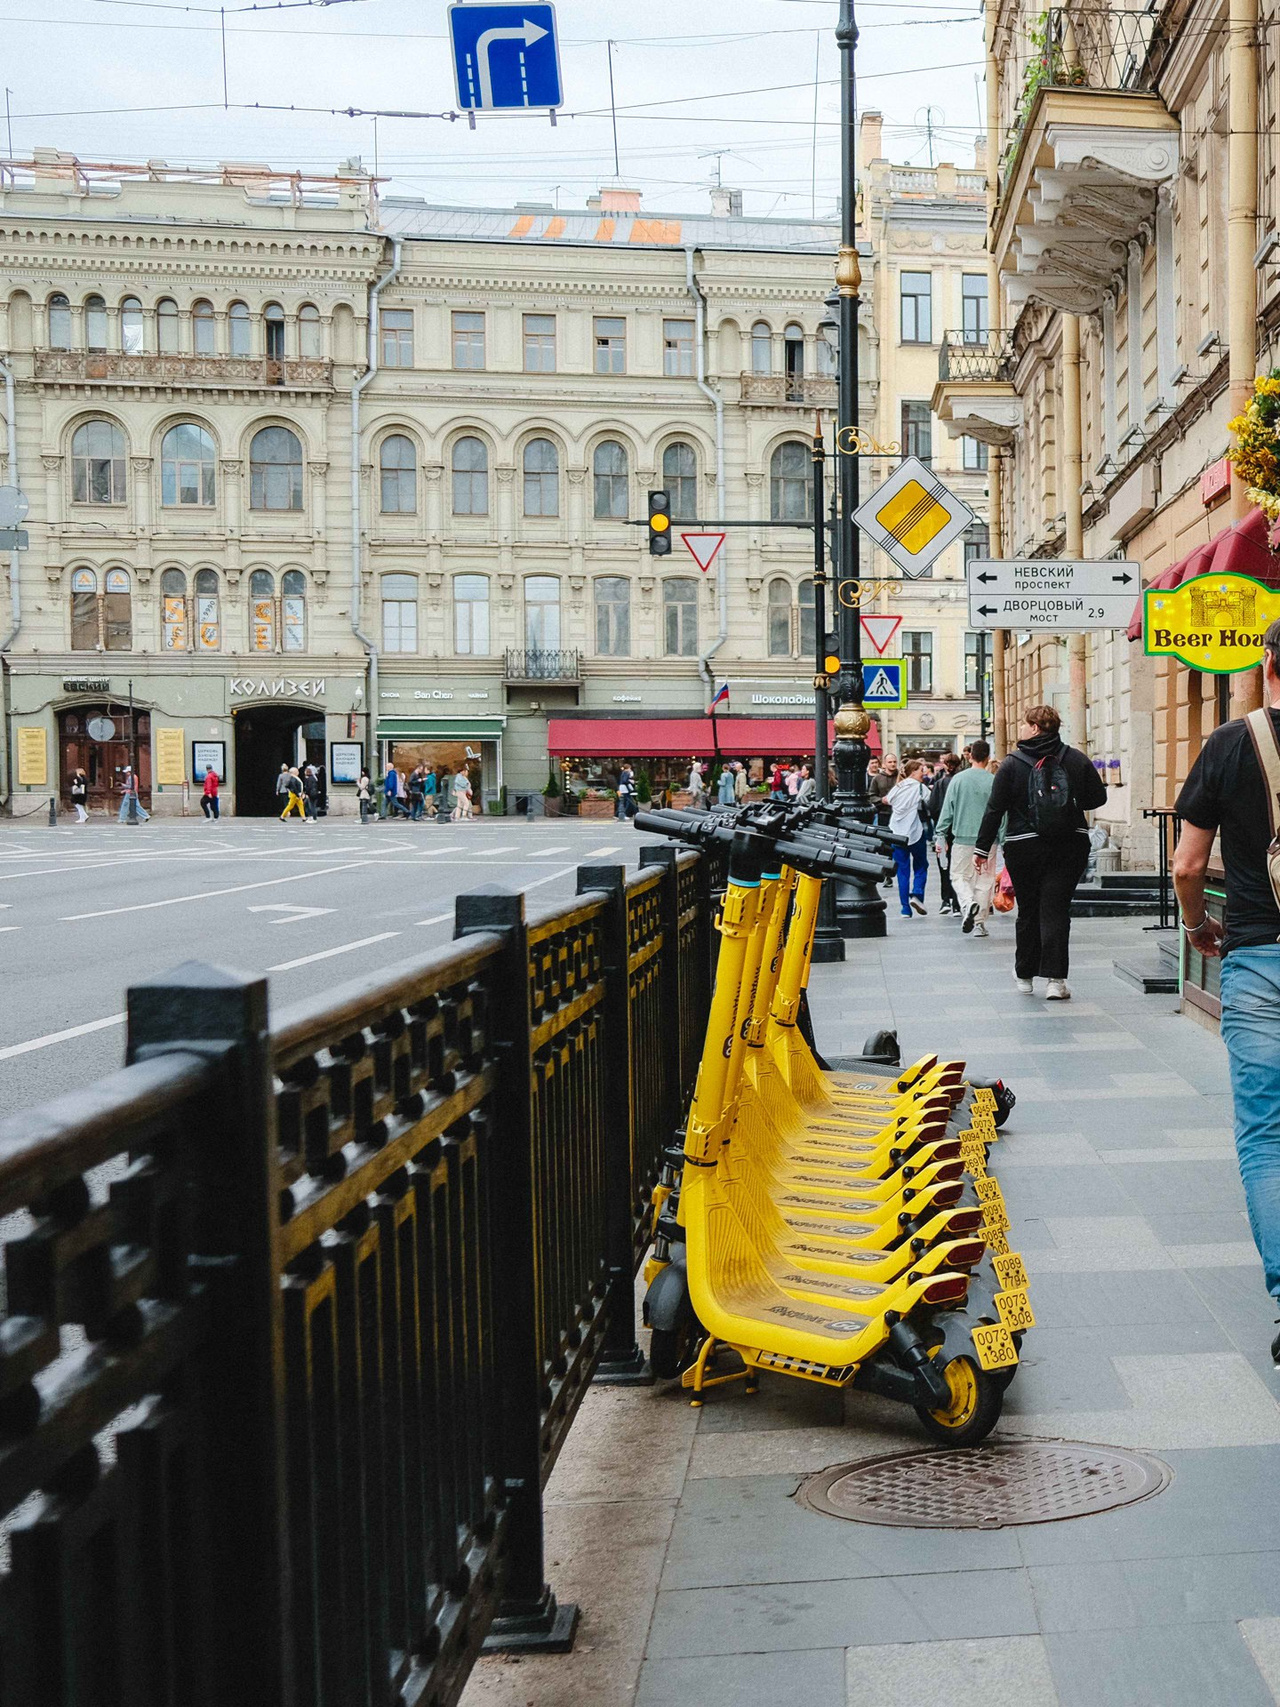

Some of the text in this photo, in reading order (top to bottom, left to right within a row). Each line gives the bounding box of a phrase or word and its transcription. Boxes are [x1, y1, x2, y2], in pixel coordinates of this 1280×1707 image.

[1014, 565, 1074, 579] НЕВСКИЙ
[1014, 580, 1070, 590] проспект
[1003, 598, 1084, 613] ДВОРЦОВЫЙ
[1029, 614, 1058, 622] мост
[1154, 629, 1265, 648] Beer Hou
[230, 679, 325, 698] КОЛИЗЕЙ
[414, 690, 431, 699] San
[752, 694, 816, 704] Шоколадни
[974, 1119, 993, 1128] 0073
[961, 1132, 980, 1142] 0094
[981, 1130, 996, 1140] 716
[978, 1181, 997, 1193] 0097
[983, 1204, 1003, 1216] 0091
[982, 1228, 1004, 1241] 0085
[997, 1257, 1021, 1272] 0089
[1002, 1274, 1027, 1288] 7794
[999, 1293, 1027, 1310] 0073
[1005, 1311, 1032, 1327] 1308
[977, 1328, 1009, 1346] 0073
[984, 1347, 1014, 1364] 1380
